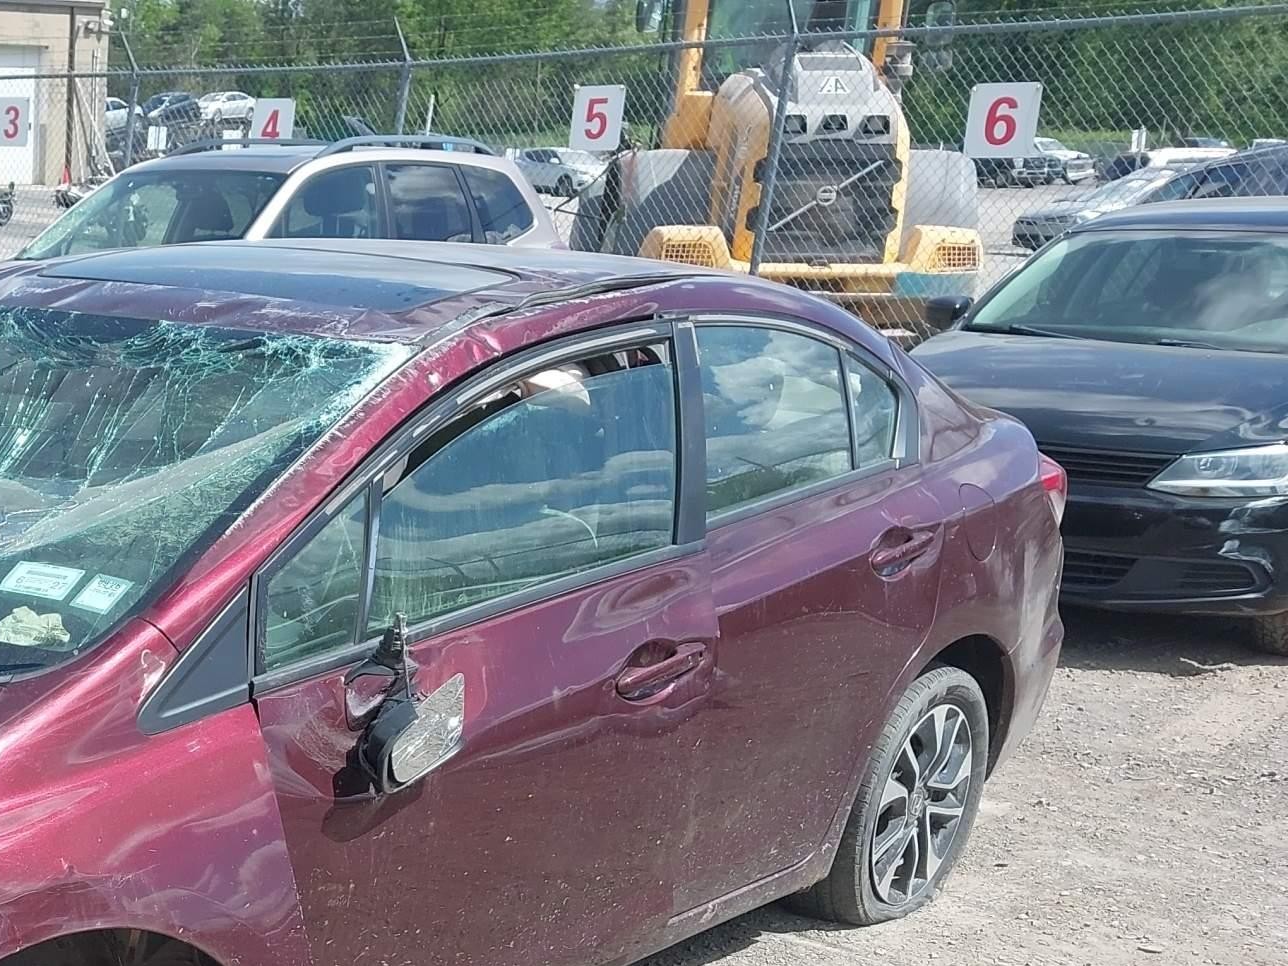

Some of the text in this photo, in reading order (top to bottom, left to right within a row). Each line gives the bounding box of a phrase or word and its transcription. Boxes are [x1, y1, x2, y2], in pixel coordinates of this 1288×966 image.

[4, 105, 19, 139] 3
[261, 109, 280, 138] 4
[585, 98, 608, 139] 5
[985, 97, 1018, 145] 6
